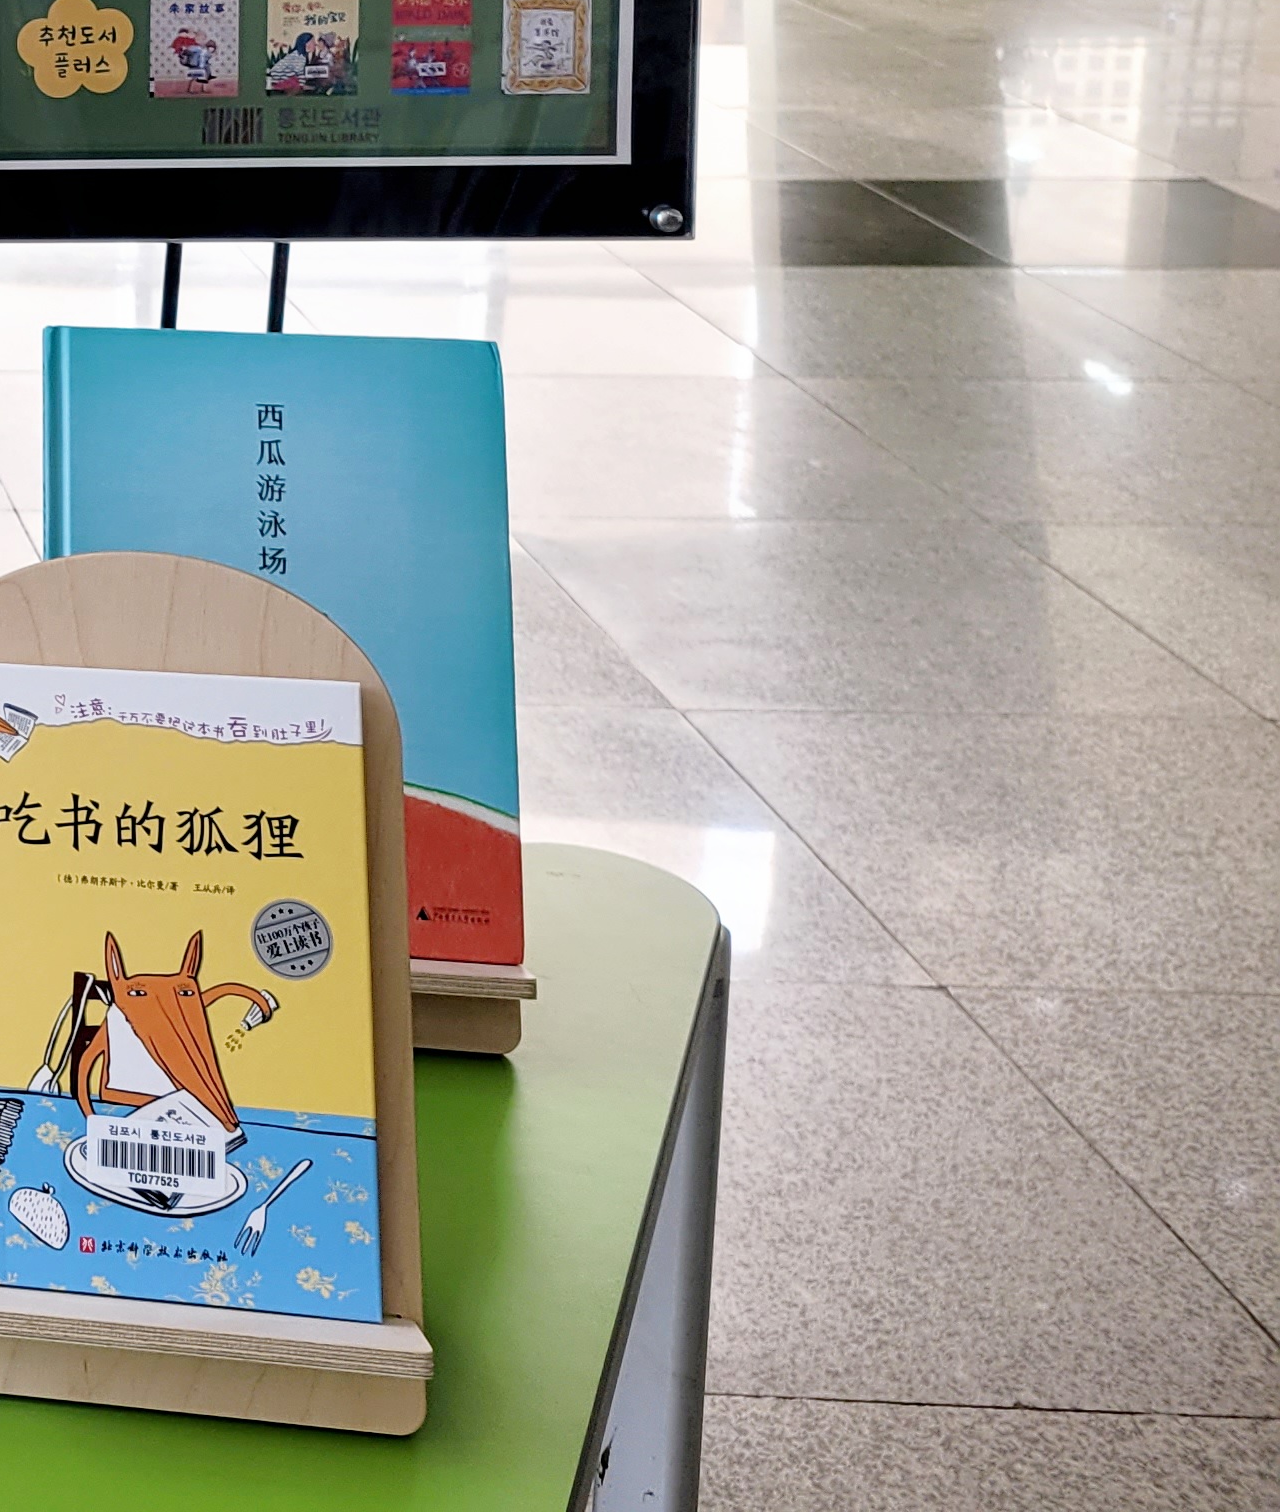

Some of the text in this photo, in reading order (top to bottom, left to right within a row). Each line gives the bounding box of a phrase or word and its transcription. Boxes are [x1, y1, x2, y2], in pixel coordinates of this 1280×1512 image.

[39, 25, 117, 48] 추천도서
[55, 53, 111, 78] 플러스
[278, 107, 383, 129] 통진도서관
[255, 403, 288, 576] 西瓜游泳场
[108, 1124, 207, 1145] 김포시 통진도서관
[128, 1171, 180, 1189] TC077525
